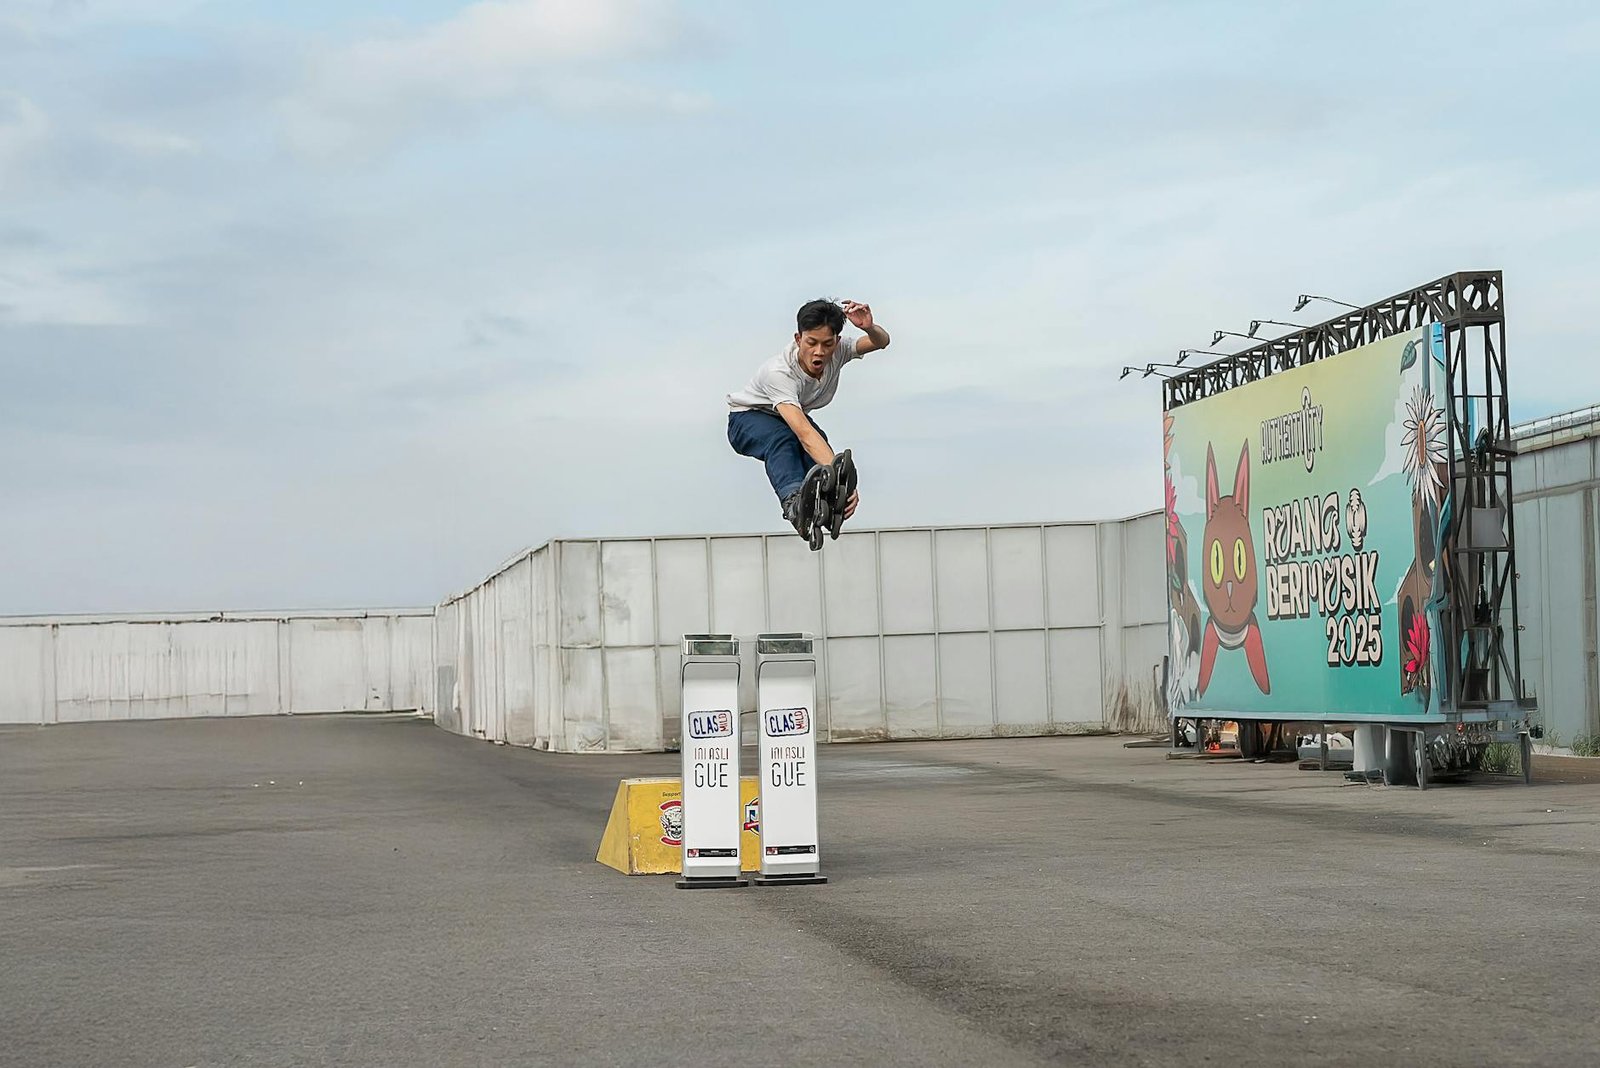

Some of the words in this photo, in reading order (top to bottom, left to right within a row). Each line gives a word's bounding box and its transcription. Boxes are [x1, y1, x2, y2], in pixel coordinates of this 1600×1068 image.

[1263, 492, 1341, 563] RUANG
[1266, 551, 1381, 621] BERMUSIK
[1326, 614, 1383, 667] 2025
[693, 715, 719, 735] CLAS
[718, 713, 729, 732] MILD
[769, 713, 795, 733] CLAS
[794, 711, 805, 730] MILD
[694, 747, 707, 760] INI
[709, 747, 729, 760] ASLI
[771, 746, 783, 760] INI
[785, 746, 805, 760] ASLI
[694, 762, 729, 788] GUE
[771, 761, 806, 787] GUE
